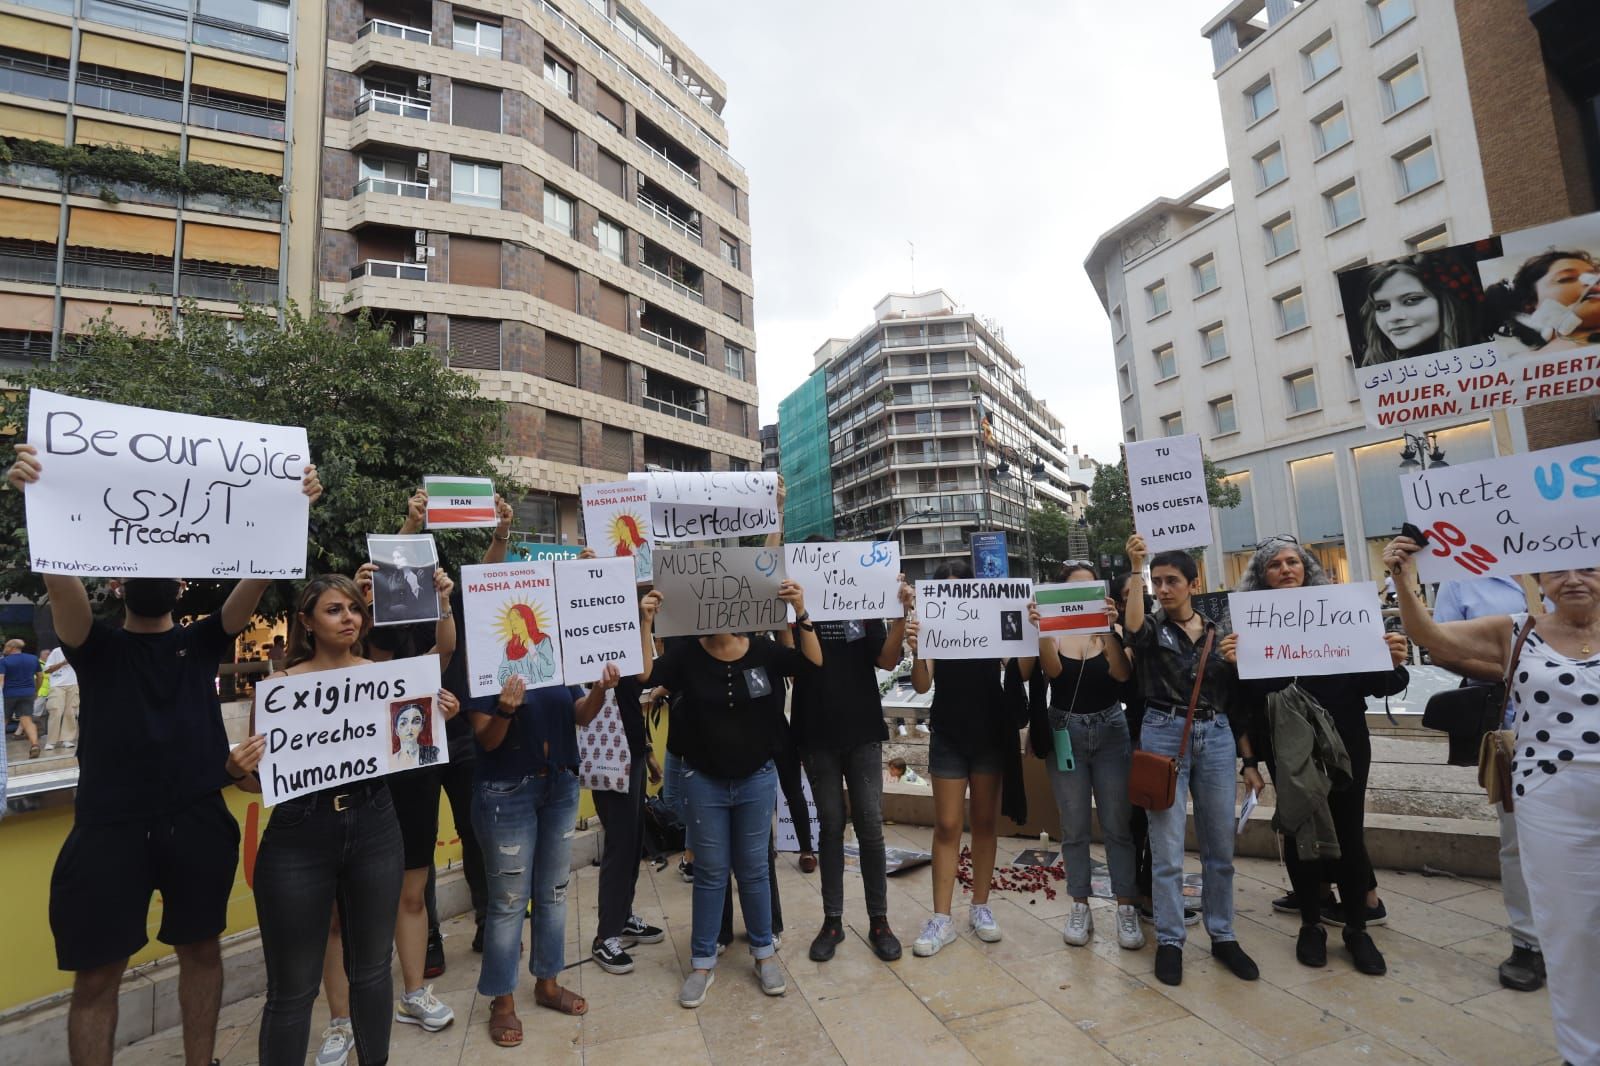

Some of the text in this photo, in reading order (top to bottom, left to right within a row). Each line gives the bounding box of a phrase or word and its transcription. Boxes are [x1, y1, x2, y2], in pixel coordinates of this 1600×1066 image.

[1470, 349, 1497, 369] ژن
[1378, 355, 1600, 407] MUJER, VIDA, LIBERT
[1377, 400, 1463, 425] WOMAN,
[1470, 389, 1518, 410] LIFE,
[45, 411, 119, 456] Be
[128, 433, 212, 467] our
[1155, 447, 1170, 457] TU
[1140, 470, 1193, 486] SILENCIO
[450, 497, 472, 507] IRAN
[586, 494, 647, 507] MASHA AMINI
[1412, 473, 1512, 511] Únete
[1136, 495, 1204, 513] NOS CUESTA
[651, 507, 741, 538] Libertad
[1496, 509, 1520, 525] a
[108, 519, 211, 545] freedom
[1151, 523, 1196, 537] LA VIDA
[659, 551, 728, 577] MUJER
[792, 545, 841, 572] Mujer
[483, 570, 508, 579] TODOS
[588, 569, 603, 579] TU
[468, 578, 551, 593] MASHA AMINI
[691, 575, 753, 600] VIDA
[922, 583, 1031, 599] #MAHSAAMINI
[570, 594, 625, 609] SILENCIO
[822, 589, 886, 611] Libertad
[1061, 604, 1084, 613] IRAN
[695, 598, 788, 632] LIBERTAD
[925, 601, 980, 621] Di Su
[1246, 599, 1371, 633] #helpIran
[564, 621, 635, 638] NOS CUESTA
[925, 629, 990, 648] Nombre
[580, 650, 626, 665] LA VIDA
[264, 678, 406, 714] Exigimos
[270, 718, 378, 754] Derechos
[272, 756, 378, 797] humanos
